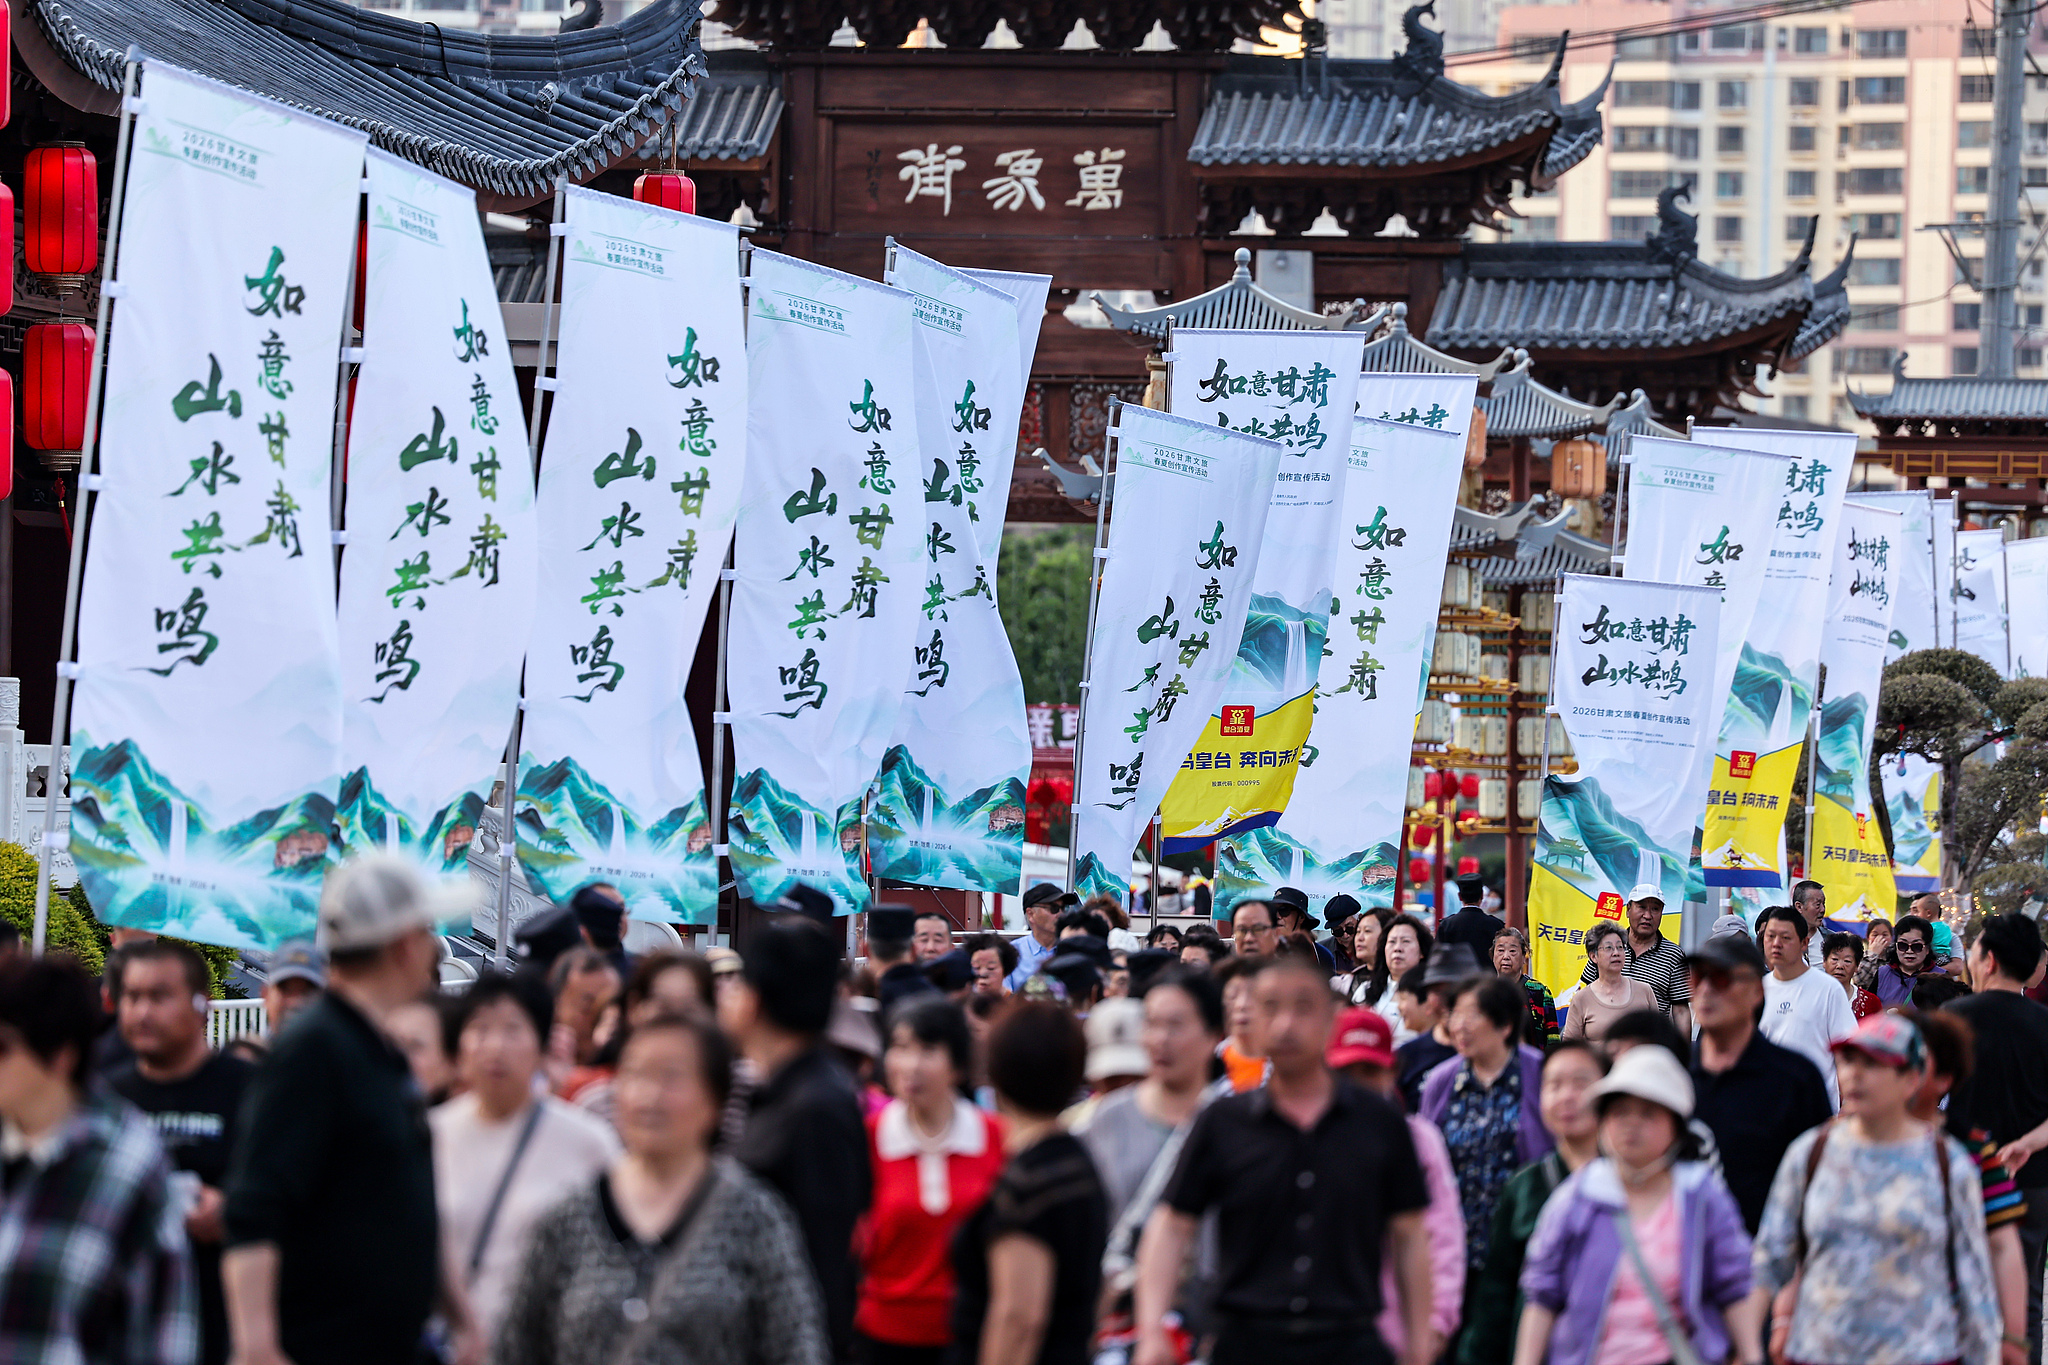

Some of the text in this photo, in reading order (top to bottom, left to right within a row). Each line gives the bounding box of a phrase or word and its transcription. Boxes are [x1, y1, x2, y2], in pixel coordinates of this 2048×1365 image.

[787, 298, 844, 321] 2026甘肃文旅
[789, 308, 846, 332] 春夏创作宣传活动
[913, 296, 963, 322] 2026甘肃文旅
[234, 245, 306, 559] 如意甘肃
[445, 297, 508, 589] 如意甘肃
[1196, 357, 1337, 410] 如意甘肃
[128, 352, 243, 677] 山水共鸣
[841, 378, 897, 620] 如意甘肃
[1153, 447, 1209, 468] 2026甘肃文旅
[1153, 457, 1209, 478] 春夏创作宣传活动
[361, 405, 459, 704] 山水共鸣
[561, 427, 656, 703] 山水共鸣
[761, 467, 838, 719] 山水共鸣
[1345, 505, 1407, 702] 如意甘肃
[1150, 519, 1238, 724] 如意甘肃
[1578, 604, 1697, 657] 如意甘肃
[1581, 653, 1688, 701] 山水共鸣
[1537, 922, 1587, 946] 天马皇
